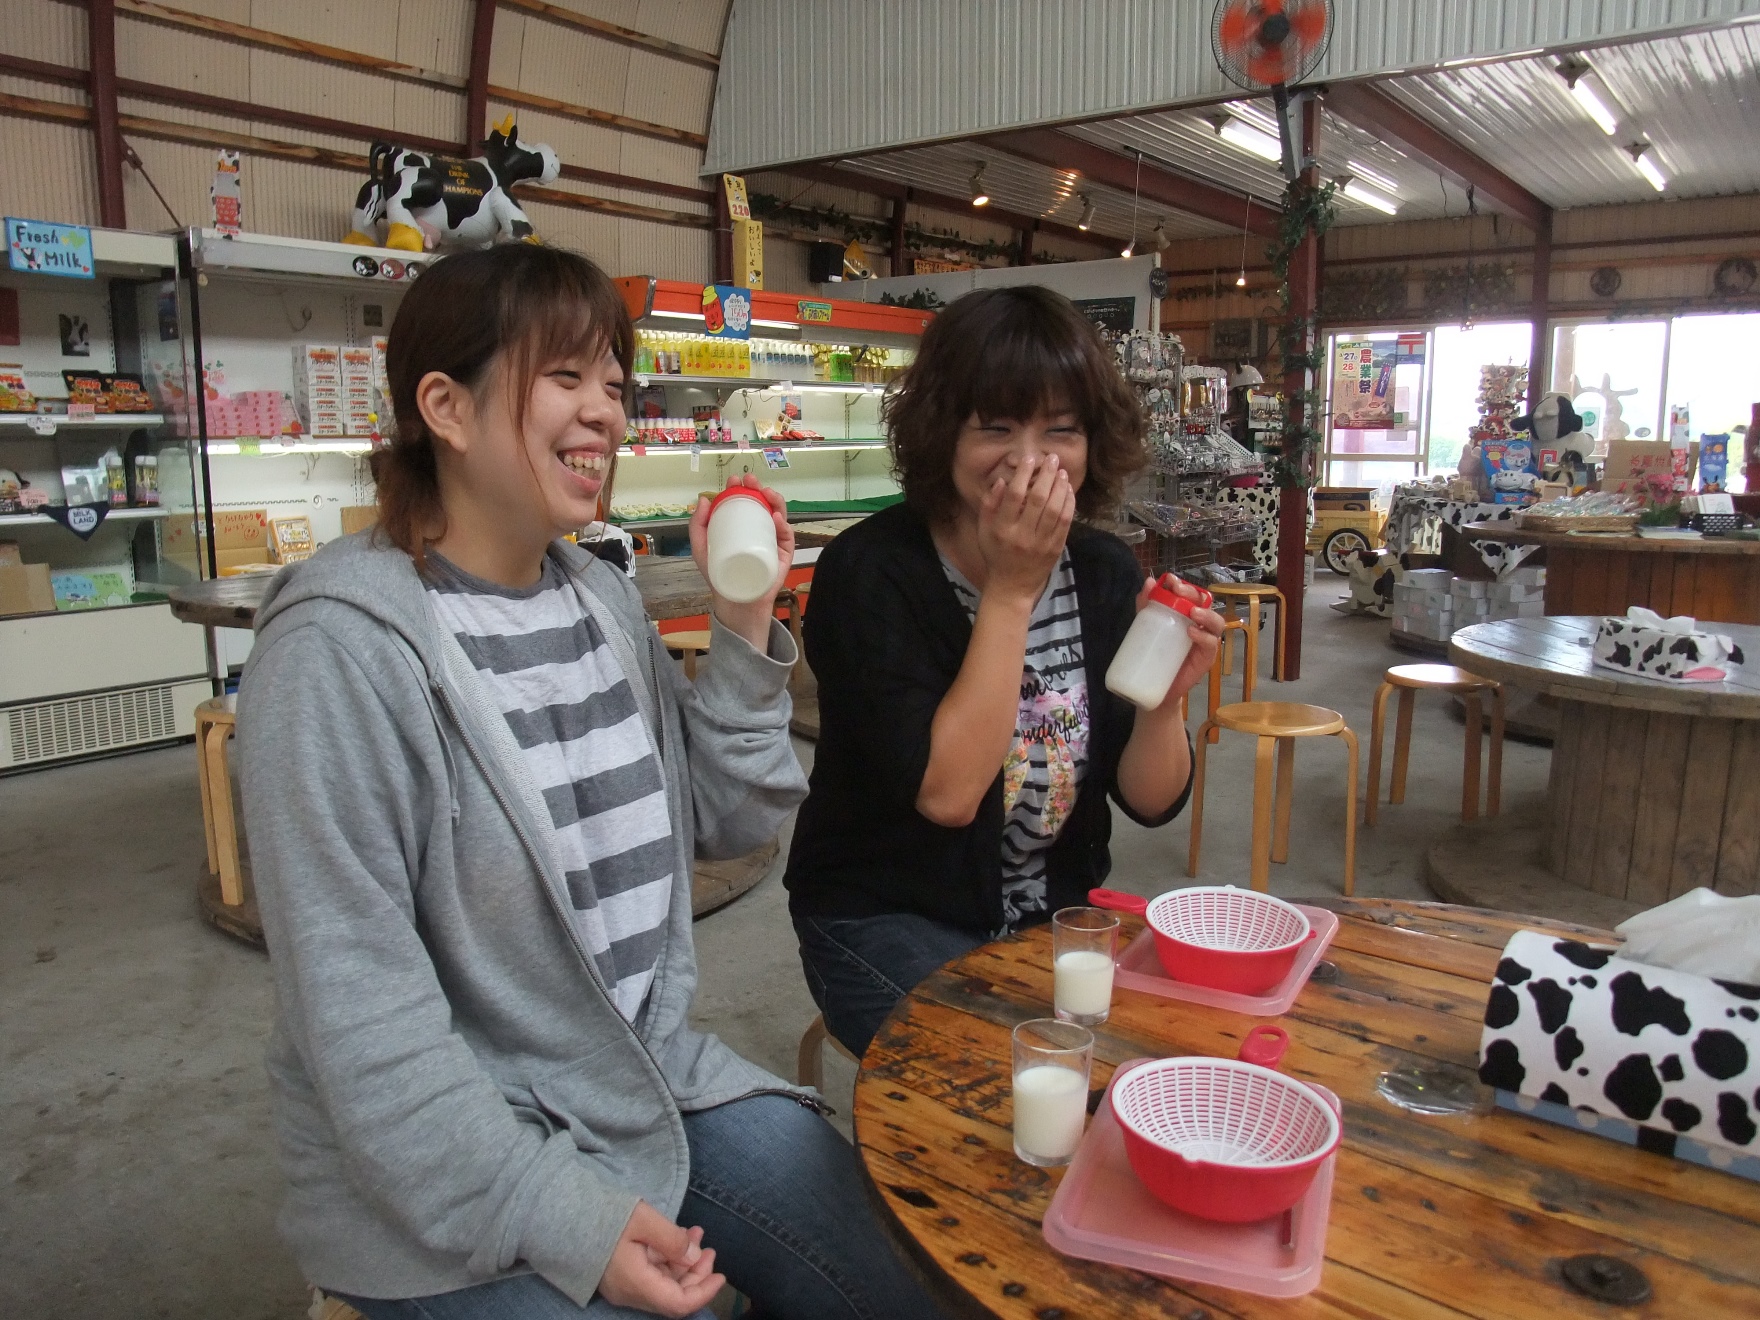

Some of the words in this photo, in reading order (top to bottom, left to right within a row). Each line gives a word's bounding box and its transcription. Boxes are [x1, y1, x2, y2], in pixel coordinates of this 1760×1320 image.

[448, 170, 470, 178] DRINK
[456, 178, 465, 186] OF
[731, 203, 750, 217] 220
[15, 225, 59, 244] Fresh
[748, 226, 757, 267] おいしいよ
[44, 251, 82, 268] Milk
[1343, 352, 1355, 361] 27
[1342, 363, 1353, 371] 28
[1359, 348, 1373, 394] 農業祭
